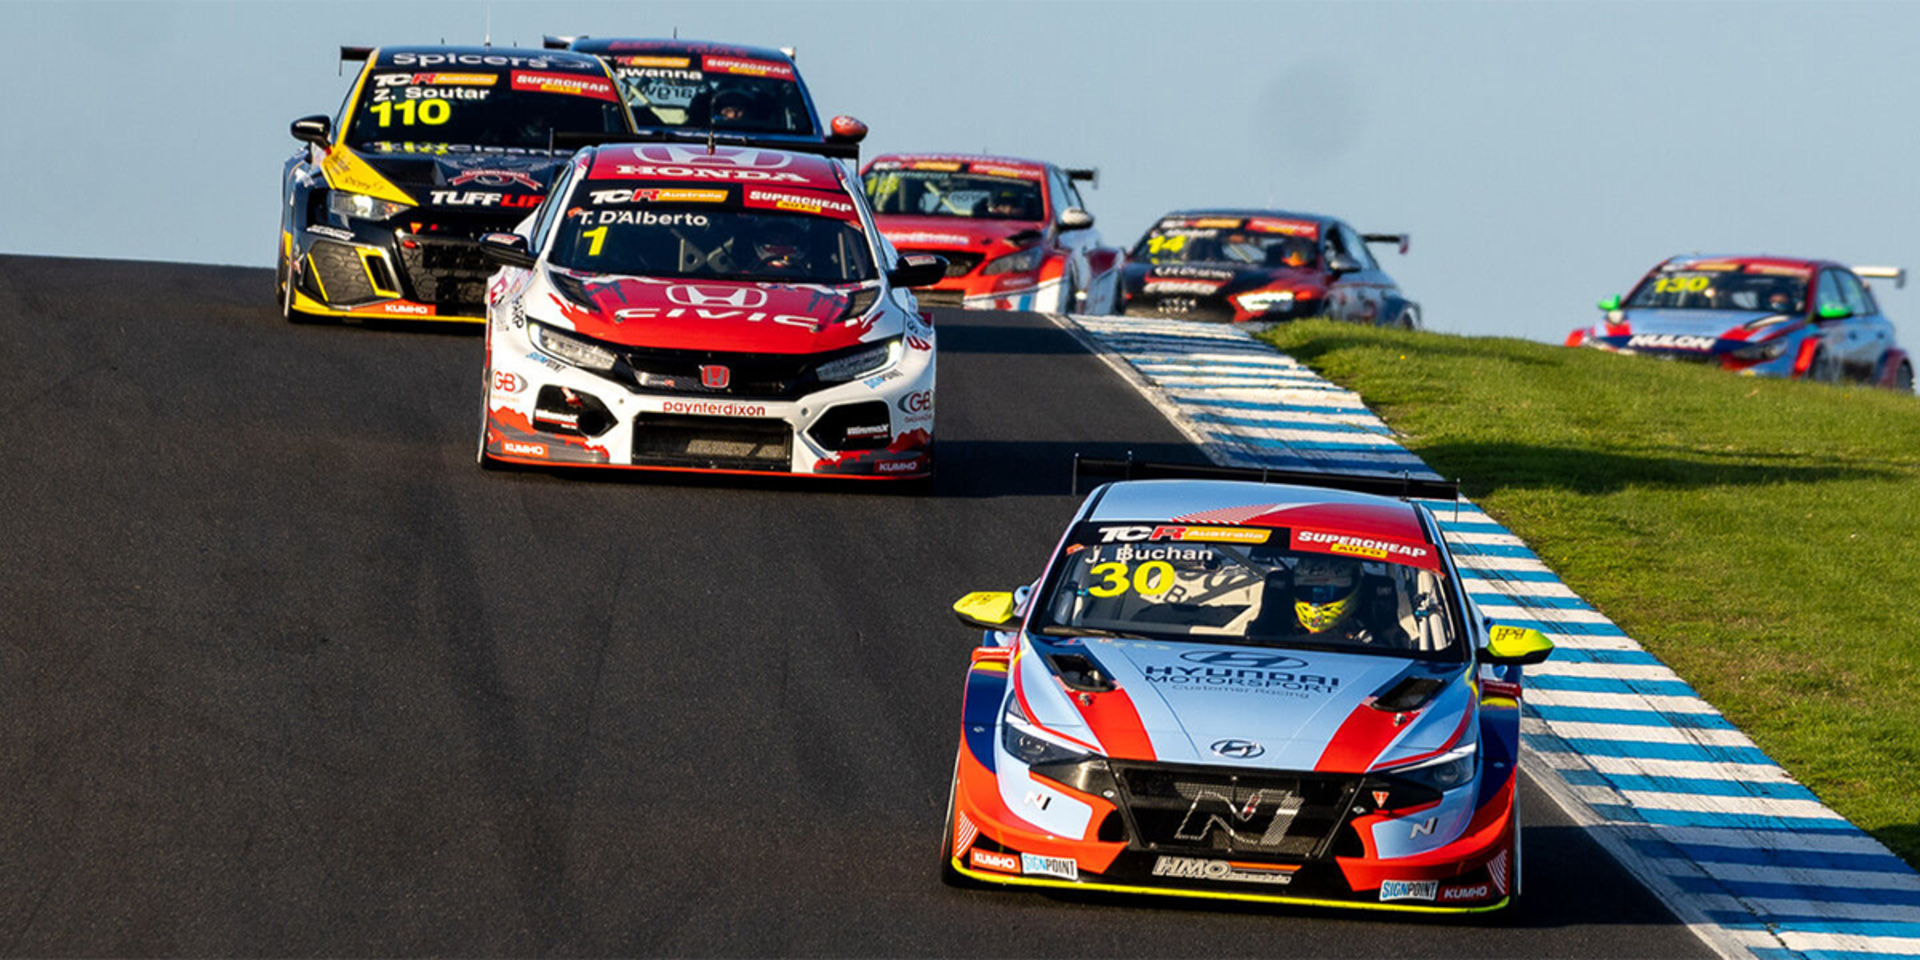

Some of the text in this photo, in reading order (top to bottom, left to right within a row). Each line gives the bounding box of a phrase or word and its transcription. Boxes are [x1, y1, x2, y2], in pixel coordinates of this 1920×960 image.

[393, 53, 548, 68] Spicers
[373, 73, 437, 87] TCR
[516, 75, 610, 92] SUPERCHEAP
[373, 87, 490, 101] Z. Soutar
[370, 98, 451, 127] 110
[616, 164, 810, 183] HONDA
[589, 188, 723, 205] TCR Australia
[749, 190, 852, 212] SUPERCHEAP
[578, 210, 708, 227] T. D'Alberto
[582, 226, 608, 257] 1
[1147, 235, 1186, 255] 14
[1652, 276, 1710, 294] 130
[385, 304, 428, 315] KUMHO
[615, 307, 819, 328] CIVIC
[1627, 334, 1717, 350] NULON
[494, 371, 516, 392] GB
[662, 401, 766, 417] paynterdixon
[504, 442, 544, 456] KUMHO
[878, 461, 917, 472] KUMHO
[1099, 526, 1265, 543] TCR Australia
[1298, 530, 1427, 558] SUPERCHEAP
[1337, 545, 1382, 556] AUTO
[1084, 546, 1213, 564] J. Buchan
[1088, 560, 1175, 598] 30
[1145, 665, 1340, 687] HYUNDAI
[1145, 675, 1340, 694] MOTORSPORT
[1255, 688, 1310, 699] Racing
[973, 851, 1016, 870] KUMHO
[1023, 854, 1076, 877] SIGNPOINT
[1152, 855, 1230, 880] HMO
[1381, 881, 1437, 899] SIGNPOINT
[1443, 886, 1488, 899] KUMHO
